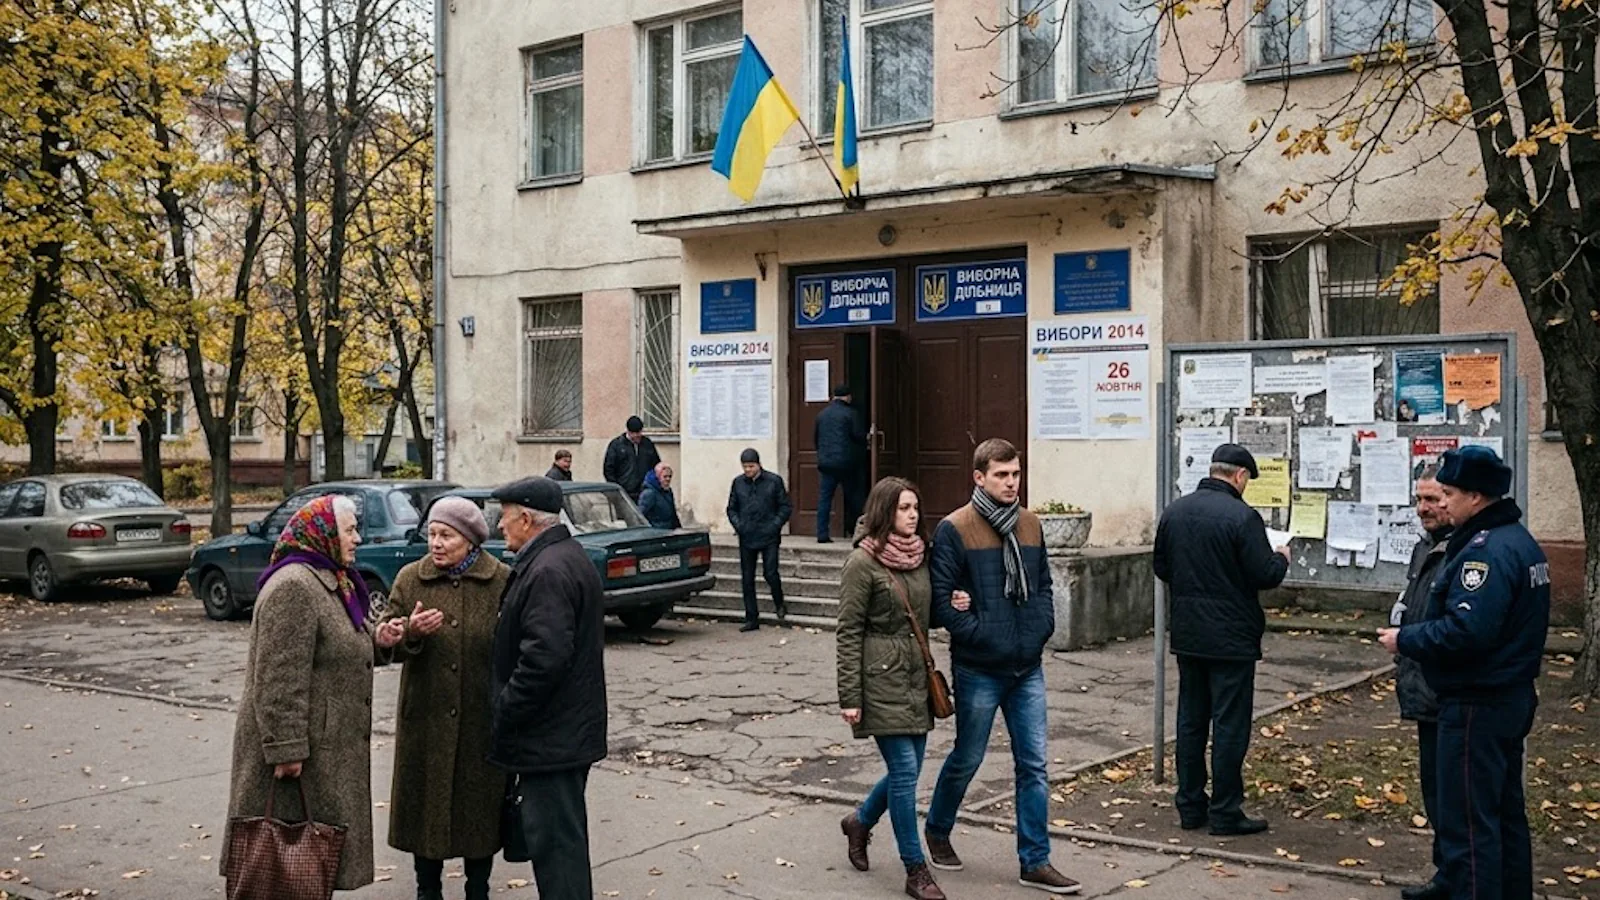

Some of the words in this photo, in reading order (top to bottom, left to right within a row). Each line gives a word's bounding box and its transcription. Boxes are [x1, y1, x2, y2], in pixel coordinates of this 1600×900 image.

[1036, 326, 1103, 342] ВИБОРИ
[1107, 323, 1145, 339] 2014
[742, 341, 769, 355] 2014
[1107, 361, 1130, 379] 26
